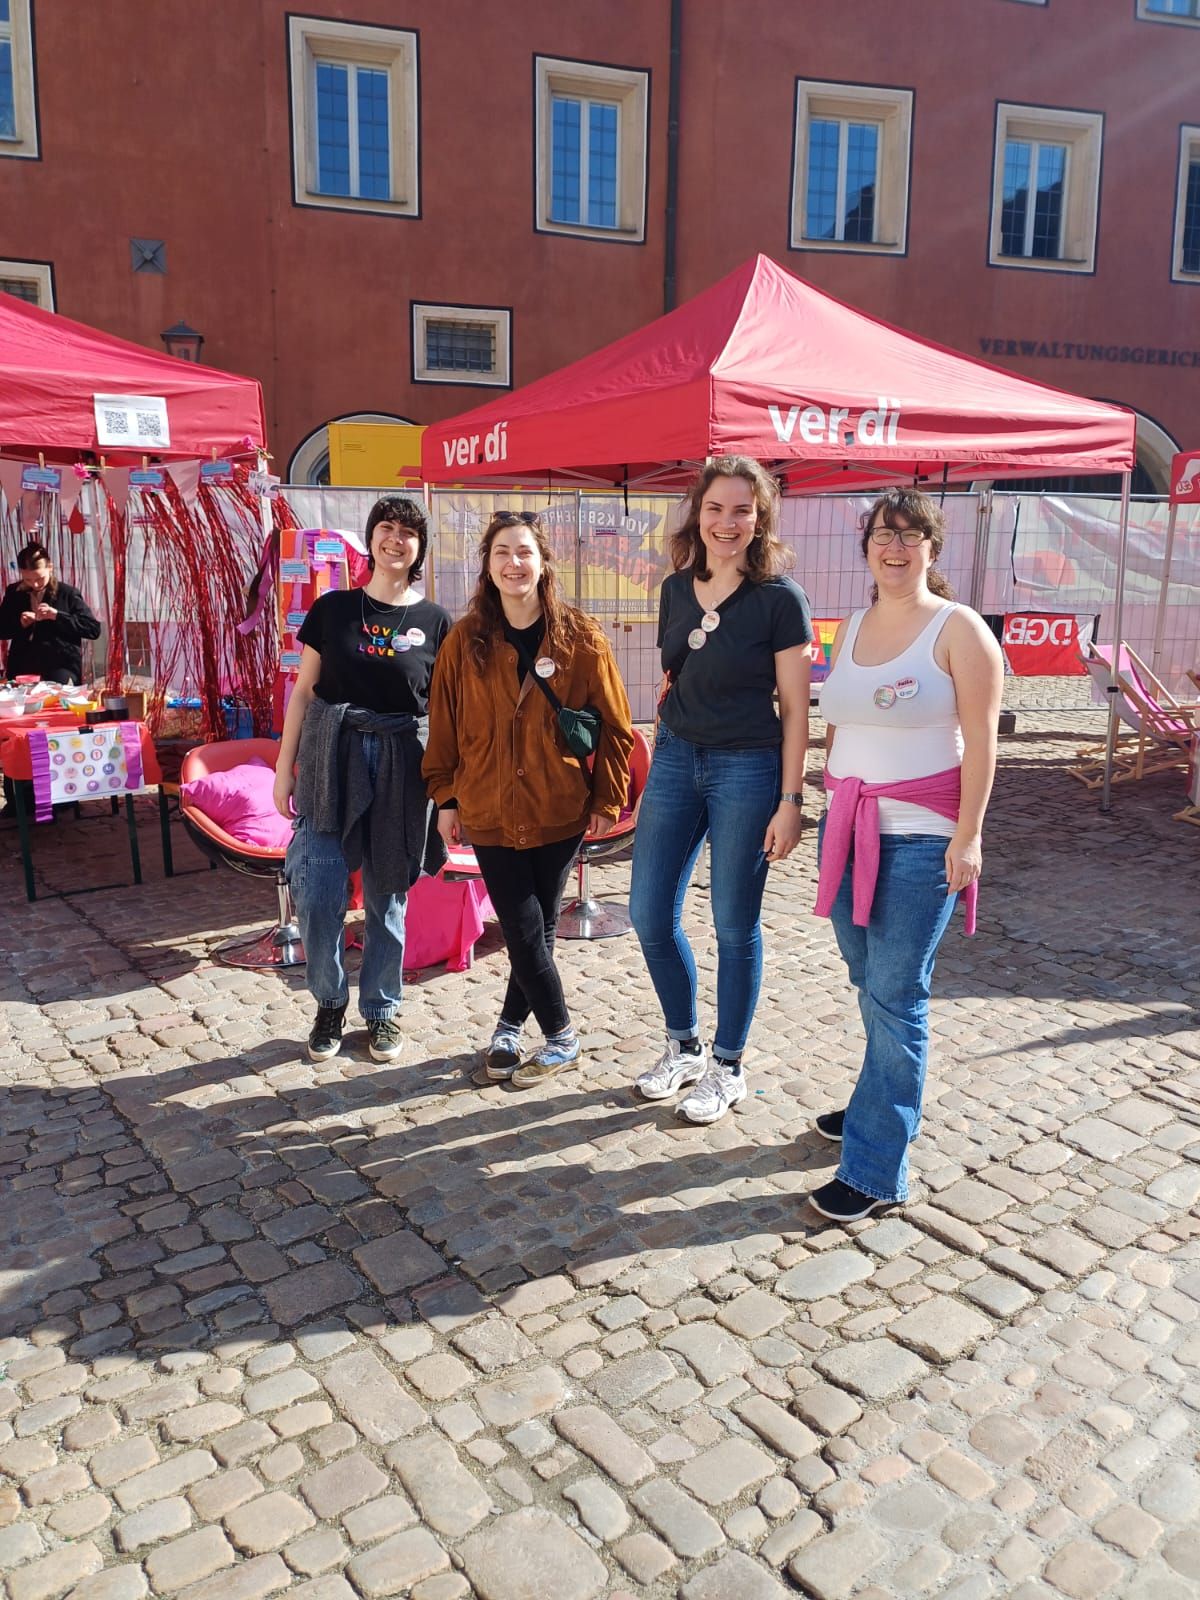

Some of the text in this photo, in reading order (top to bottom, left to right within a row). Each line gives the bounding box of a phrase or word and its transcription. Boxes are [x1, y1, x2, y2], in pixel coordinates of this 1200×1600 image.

[768, 397, 901, 446] ver.di
[442, 421, 508, 467] ver.di
[363, 624, 398, 638] LOVE
[372, 636, 385, 646] IS
[359, 643, 395, 657] LOVE
